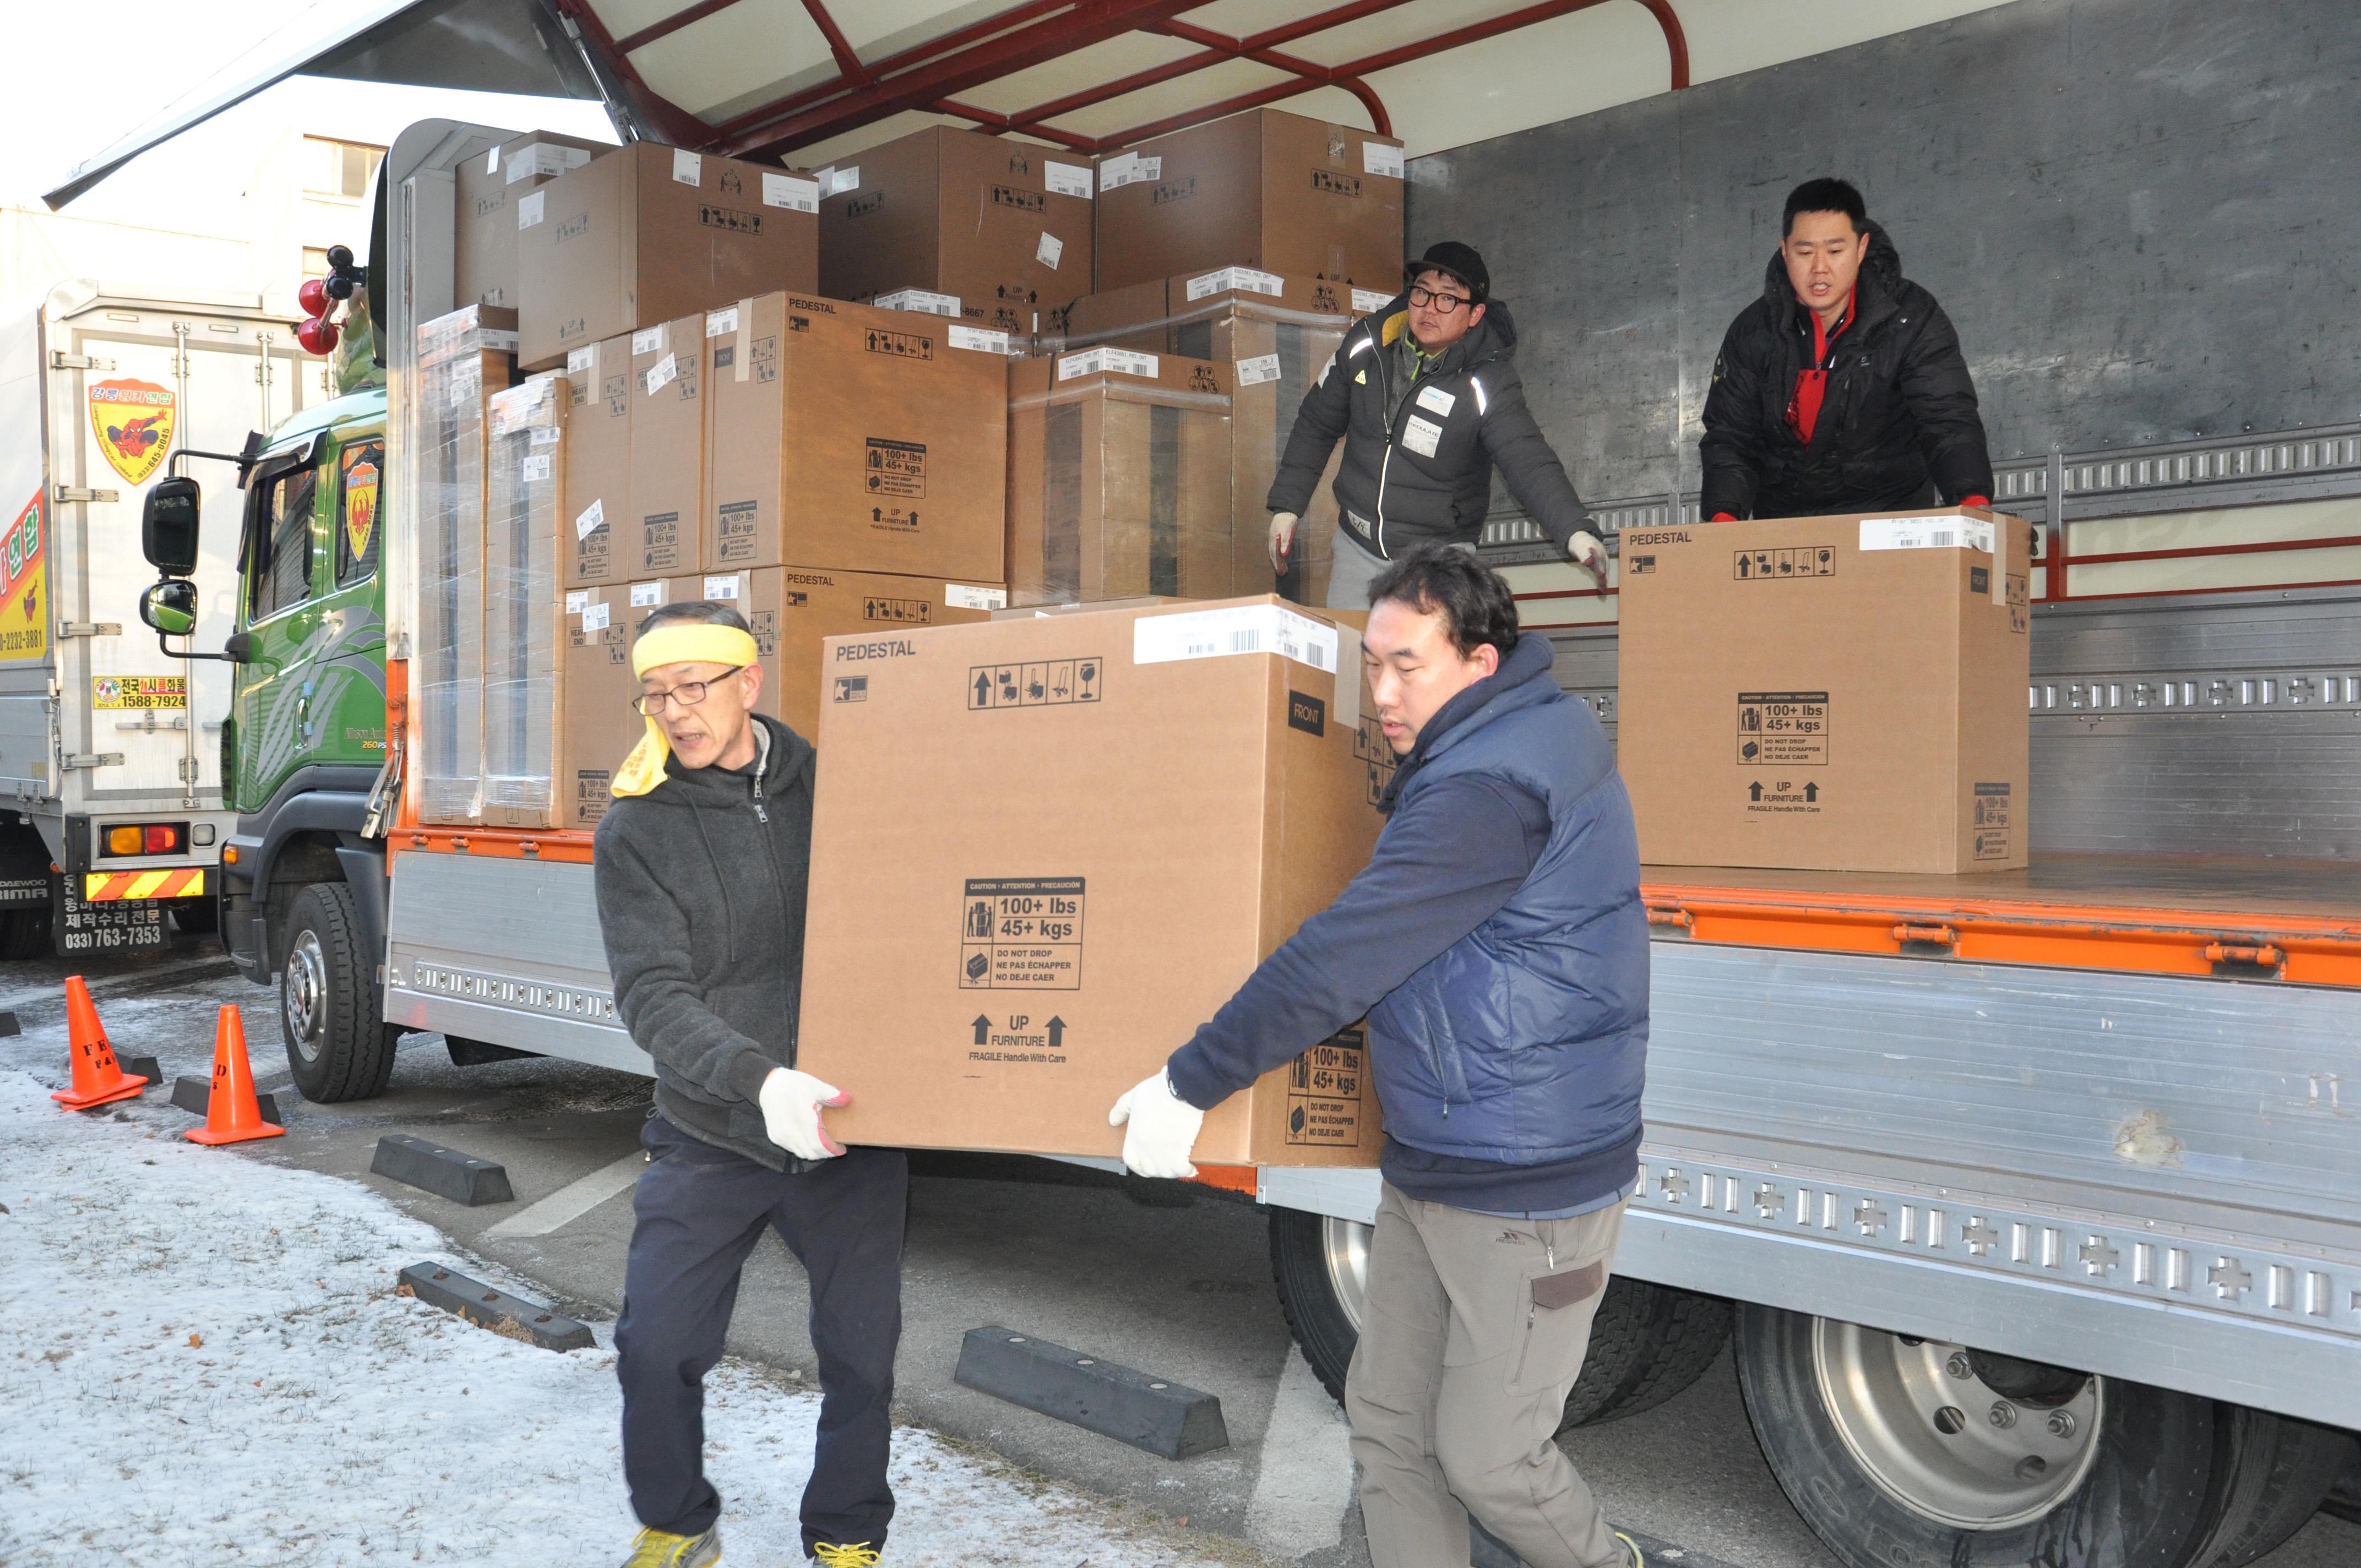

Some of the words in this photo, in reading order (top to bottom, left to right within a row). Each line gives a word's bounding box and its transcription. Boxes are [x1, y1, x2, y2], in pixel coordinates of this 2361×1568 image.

[790, 298, 836, 314] PEDESTAL
[885, 449, 906, 460] 100+
[909, 453, 922, 462] lbs
[885, 460, 902, 470] 45+
[905, 464, 921, 474] kgs
[731, 513, 744, 522] 100+
[655, 524, 666, 532] 100+
[731, 524, 742, 533] 45+
[743, 524, 753, 533] kgs
[655, 535, 664, 543] 45+
[666, 534, 675, 543] kgs
[1630, 531, 1692, 545] PEDESTAL
[787, 574, 834, 586] PEDESTAL
[836, 640, 916, 661] PEDESTAL
[122, 695, 186, 707] 1588-7924
[1294, 703, 1319, 725] FRONT
[1765, 705, 1798, 716] 100+
[1803, 705, 1823, 716] lbs
[1766, 720, 1791, 730] 45+
[1796, 719, 1820, 732] kgs
[1777, 782, 1791, 792] UP
[1000, 897, 1043, 914] 100+
[1050, 897, 1076, 913] lbs
[1001, 919, 1033, 936] 45+
[1040, 920, 1072, 940] kgs
[66, 933, 92, 949] 033)
[94, 925, 160, 947] 763-7353
[1028, 961, 1071, 969] ÉCHAPPER
[1010, 1015, 1030, 1030] UP
[992, 1036, 1045, 1046] FURNITURE
[969, 1052, 1002, 1061] FRAGILE
[1003, 1053, 1029, 1062] Handle
[1030, 1053, 1046, 1062] With
[1048, 1054, 1066, 1063] Care
[1314, 1048, 1339, 1067] 100+
[1343, 1050, 1358, 1068] lbs
[1314, 1071, 1333, 1089] 45+
[1337, 1073, 1356, 1095] kgs
[1318, 1115, 1328, 1124] PAS
[1309, 1128, 1316, 1136] NO
